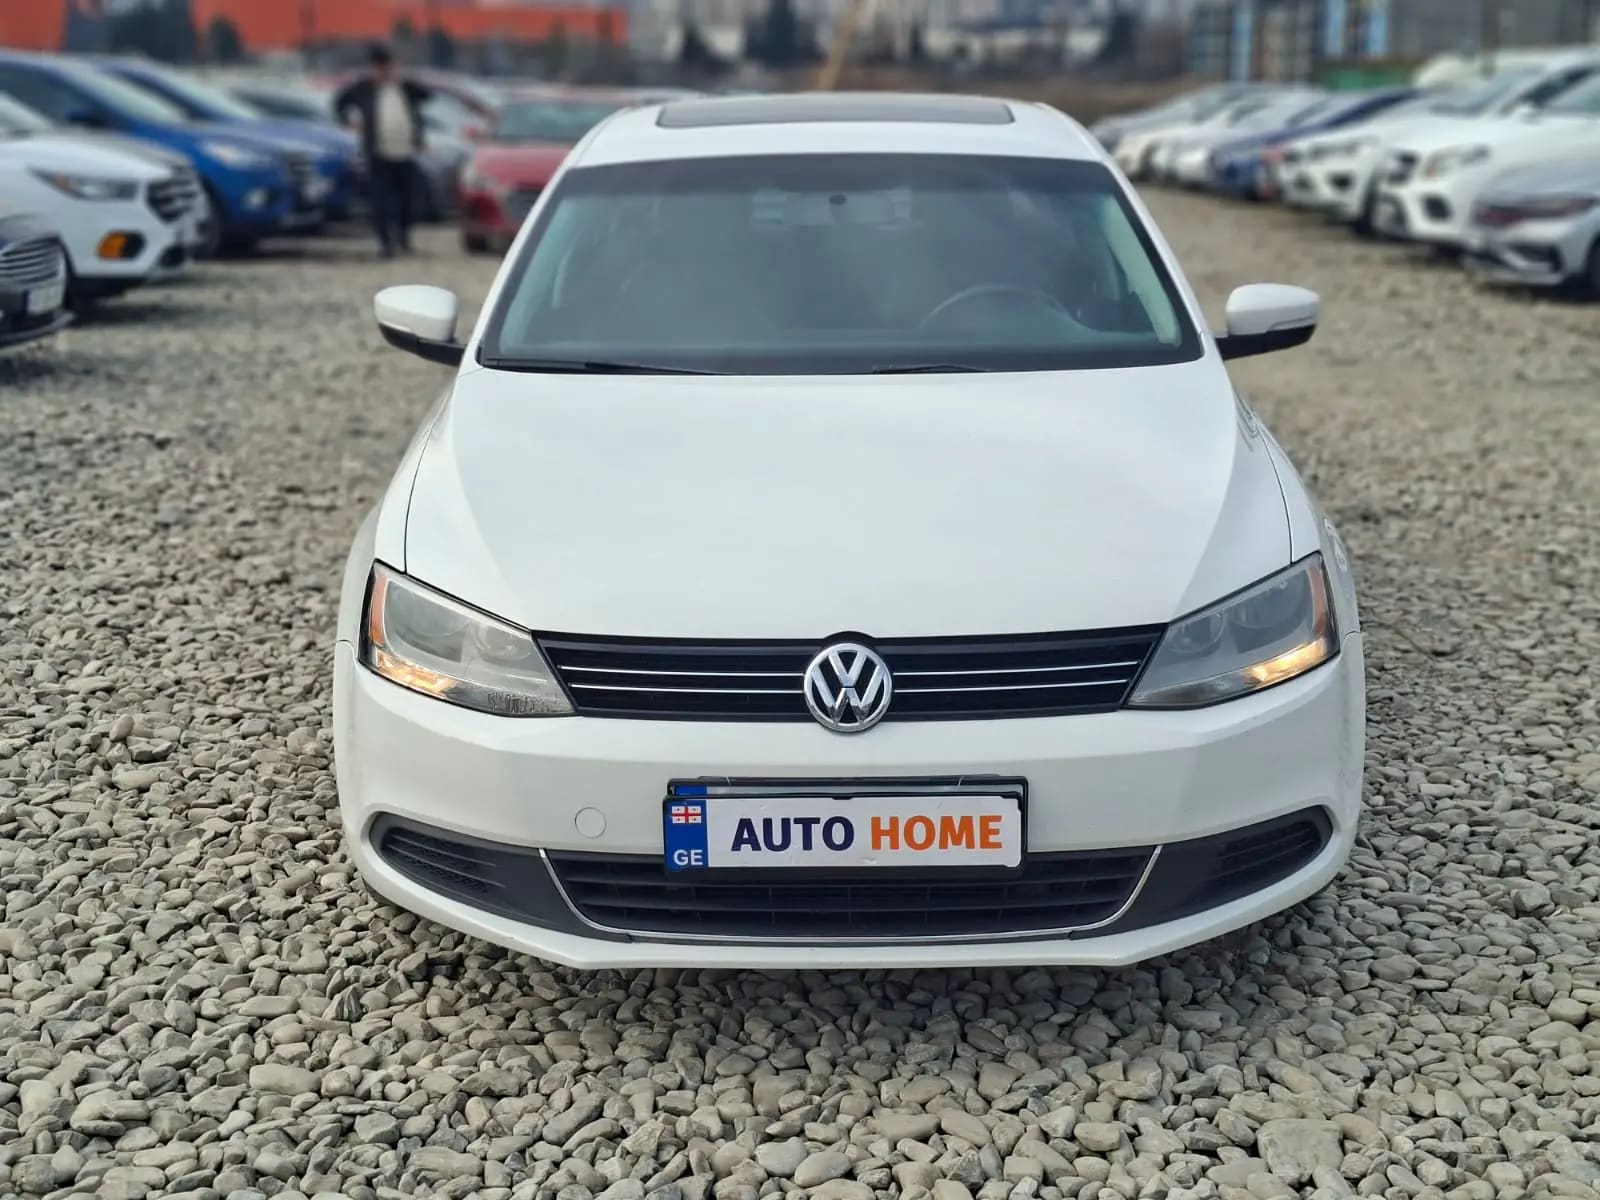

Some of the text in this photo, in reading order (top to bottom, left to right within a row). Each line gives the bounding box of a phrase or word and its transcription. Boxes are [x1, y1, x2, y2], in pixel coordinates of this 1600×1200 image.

[731, 815, 1003, 852] AUTO HOME
[673, 849, 703, 866] GE
